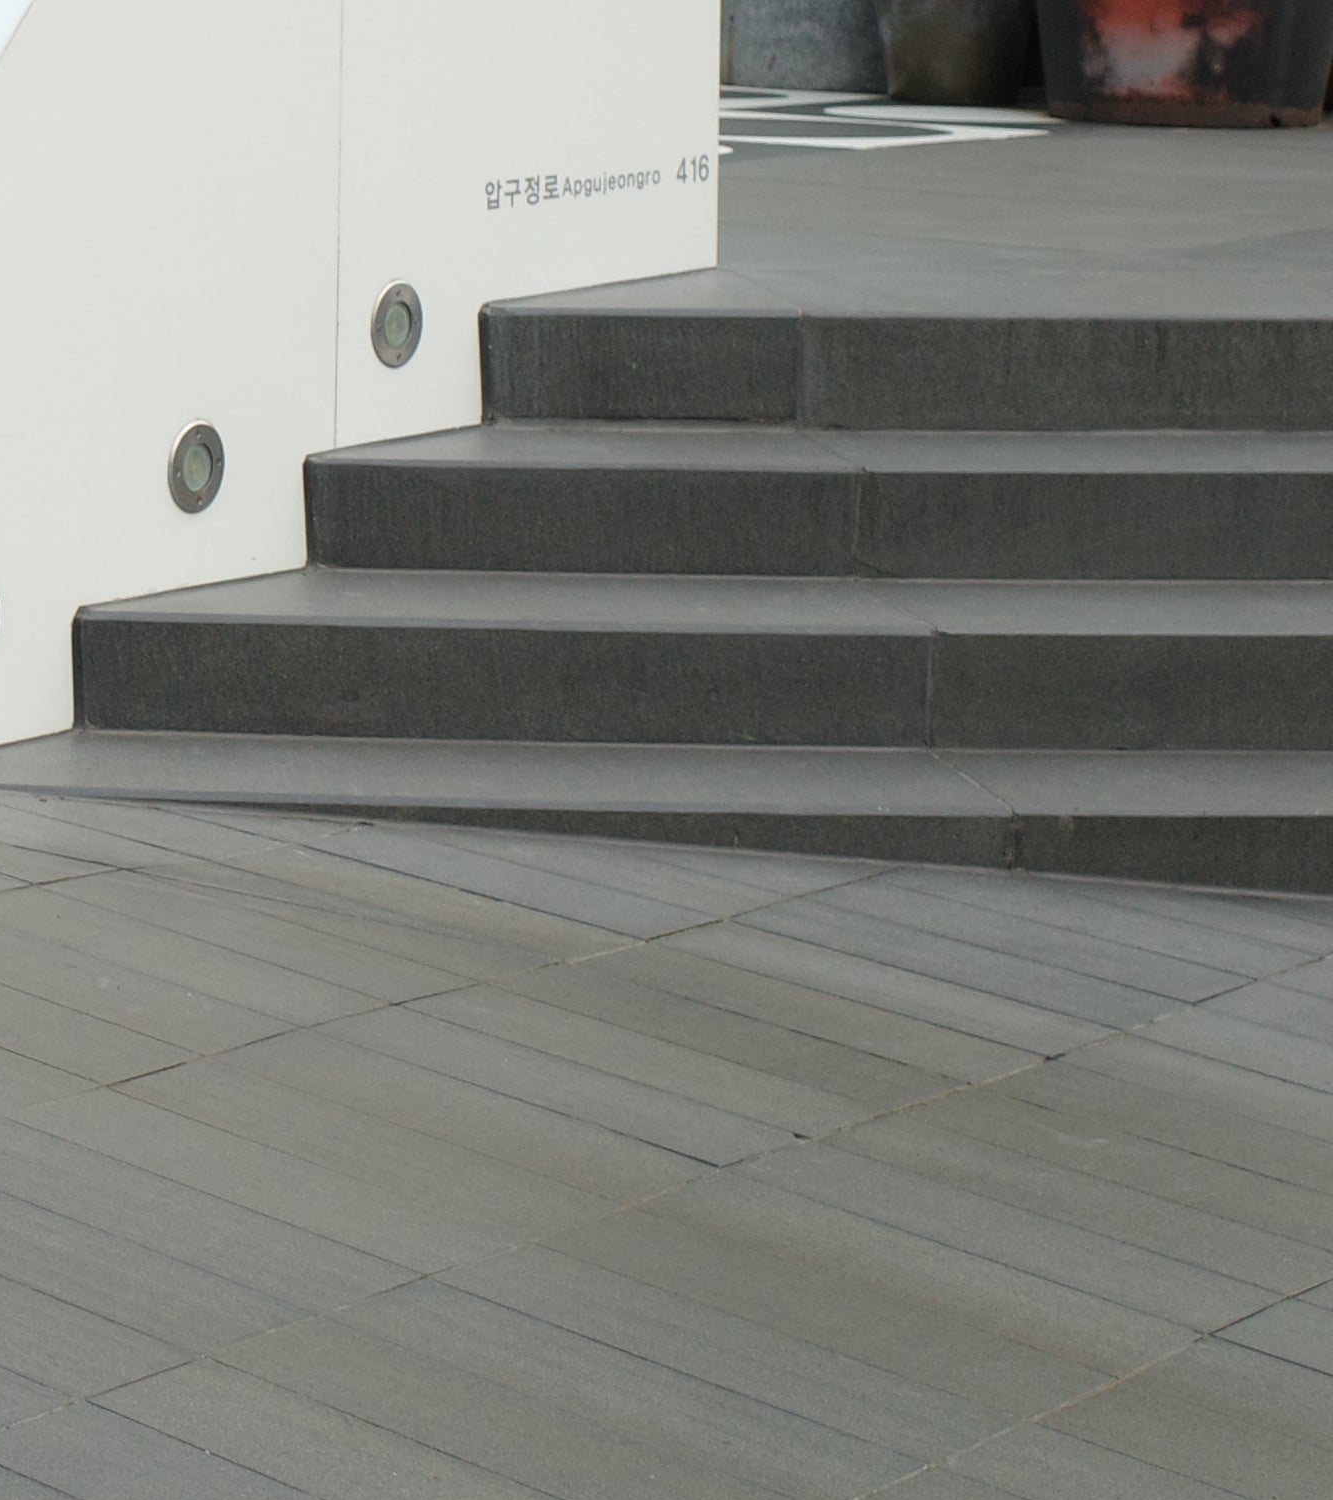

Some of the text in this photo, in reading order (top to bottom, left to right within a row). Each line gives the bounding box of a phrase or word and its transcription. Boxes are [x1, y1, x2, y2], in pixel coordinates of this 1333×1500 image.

[484, 154, 711, 211] 압구정로 Apgujeongro 416
